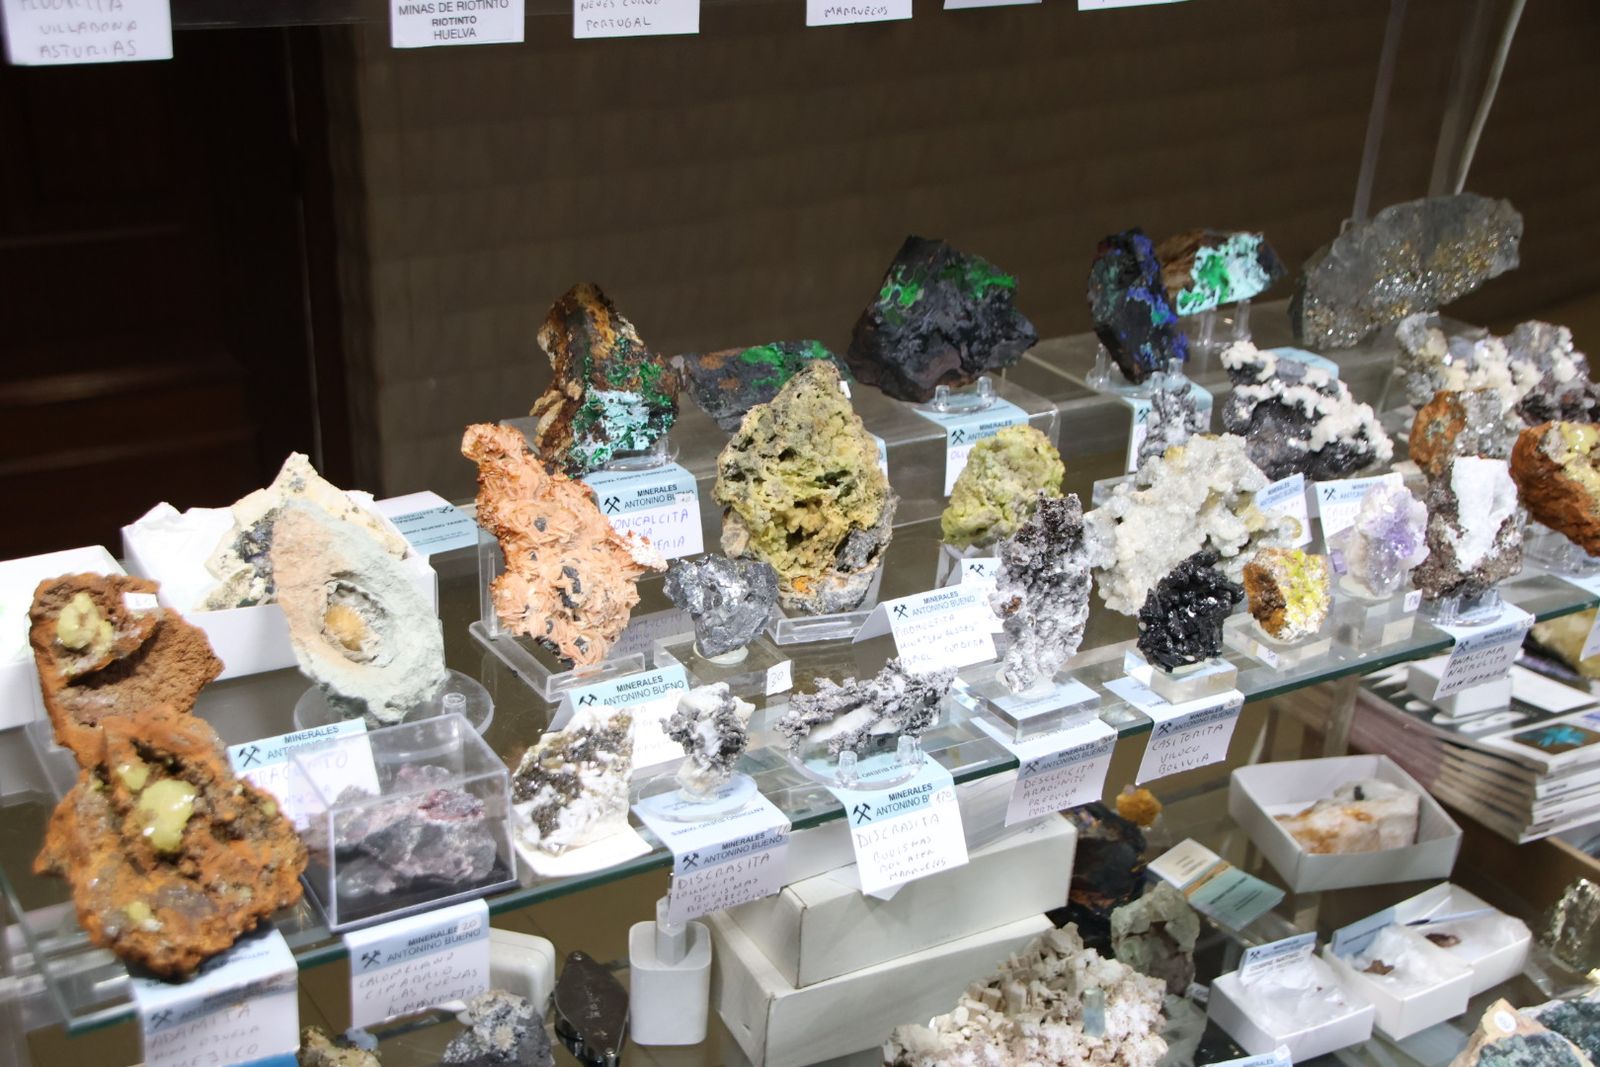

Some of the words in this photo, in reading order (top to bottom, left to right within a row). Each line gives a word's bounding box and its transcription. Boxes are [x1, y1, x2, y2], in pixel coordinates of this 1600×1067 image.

[398, 3, 436, 16] MINAS
[438, 2, 454, 13] DE
[457, 0, 509, 11] RIOTINTO
[432, 15, 477, 27] RIOTINTO
[586, 17, 652, 31] PORTUGAL
[433, 27, 477, 40] HUELVA
[40, 40, 137, 58] ASTURIAS
[979, 420, 1012, 431] MINERALES
[637, 484, 678, 497] MINERALES
[624, 495, 665, 509] ANTONINO
[912, 600, 949, 616] ANTONINO
[951, 595, 976, 608] BUENO
[923, 591, 959, 605] MINERALES
[616, 675, 664, 692] MINERALES
[603, 688, 651, 706] ANTONINO
[652, 680, 685, 695] BUENO
[1173, 715, 1210, 731] ANTONINO
[1210, 709, 1236, 722] BUENO
[1189, 706, 1224, 720] MINERALES
[284, 726, 339, 744] MINERALES
[1041, 753, 1080, 770] ANTONINO
[1081, 745, 1109, 759] BUENO
[1058, 744, 1095, 758] MINERALES
[1158, 753, 1209, 775] BOLIVIA
[888, 783, 933, 801] MINERALES
[876, 797, 921, 817] ANTONINO
[703, 844, 751, 865] ANTONINO
[751, 834, 784, 851] BUENO
[721, 832, 766, 850] MINERALES
[677, 852, 770, 890] DISCRASITA
[387, 938, 442, 962] ANTONINO
[445, 928, 481, 945] BUENO
